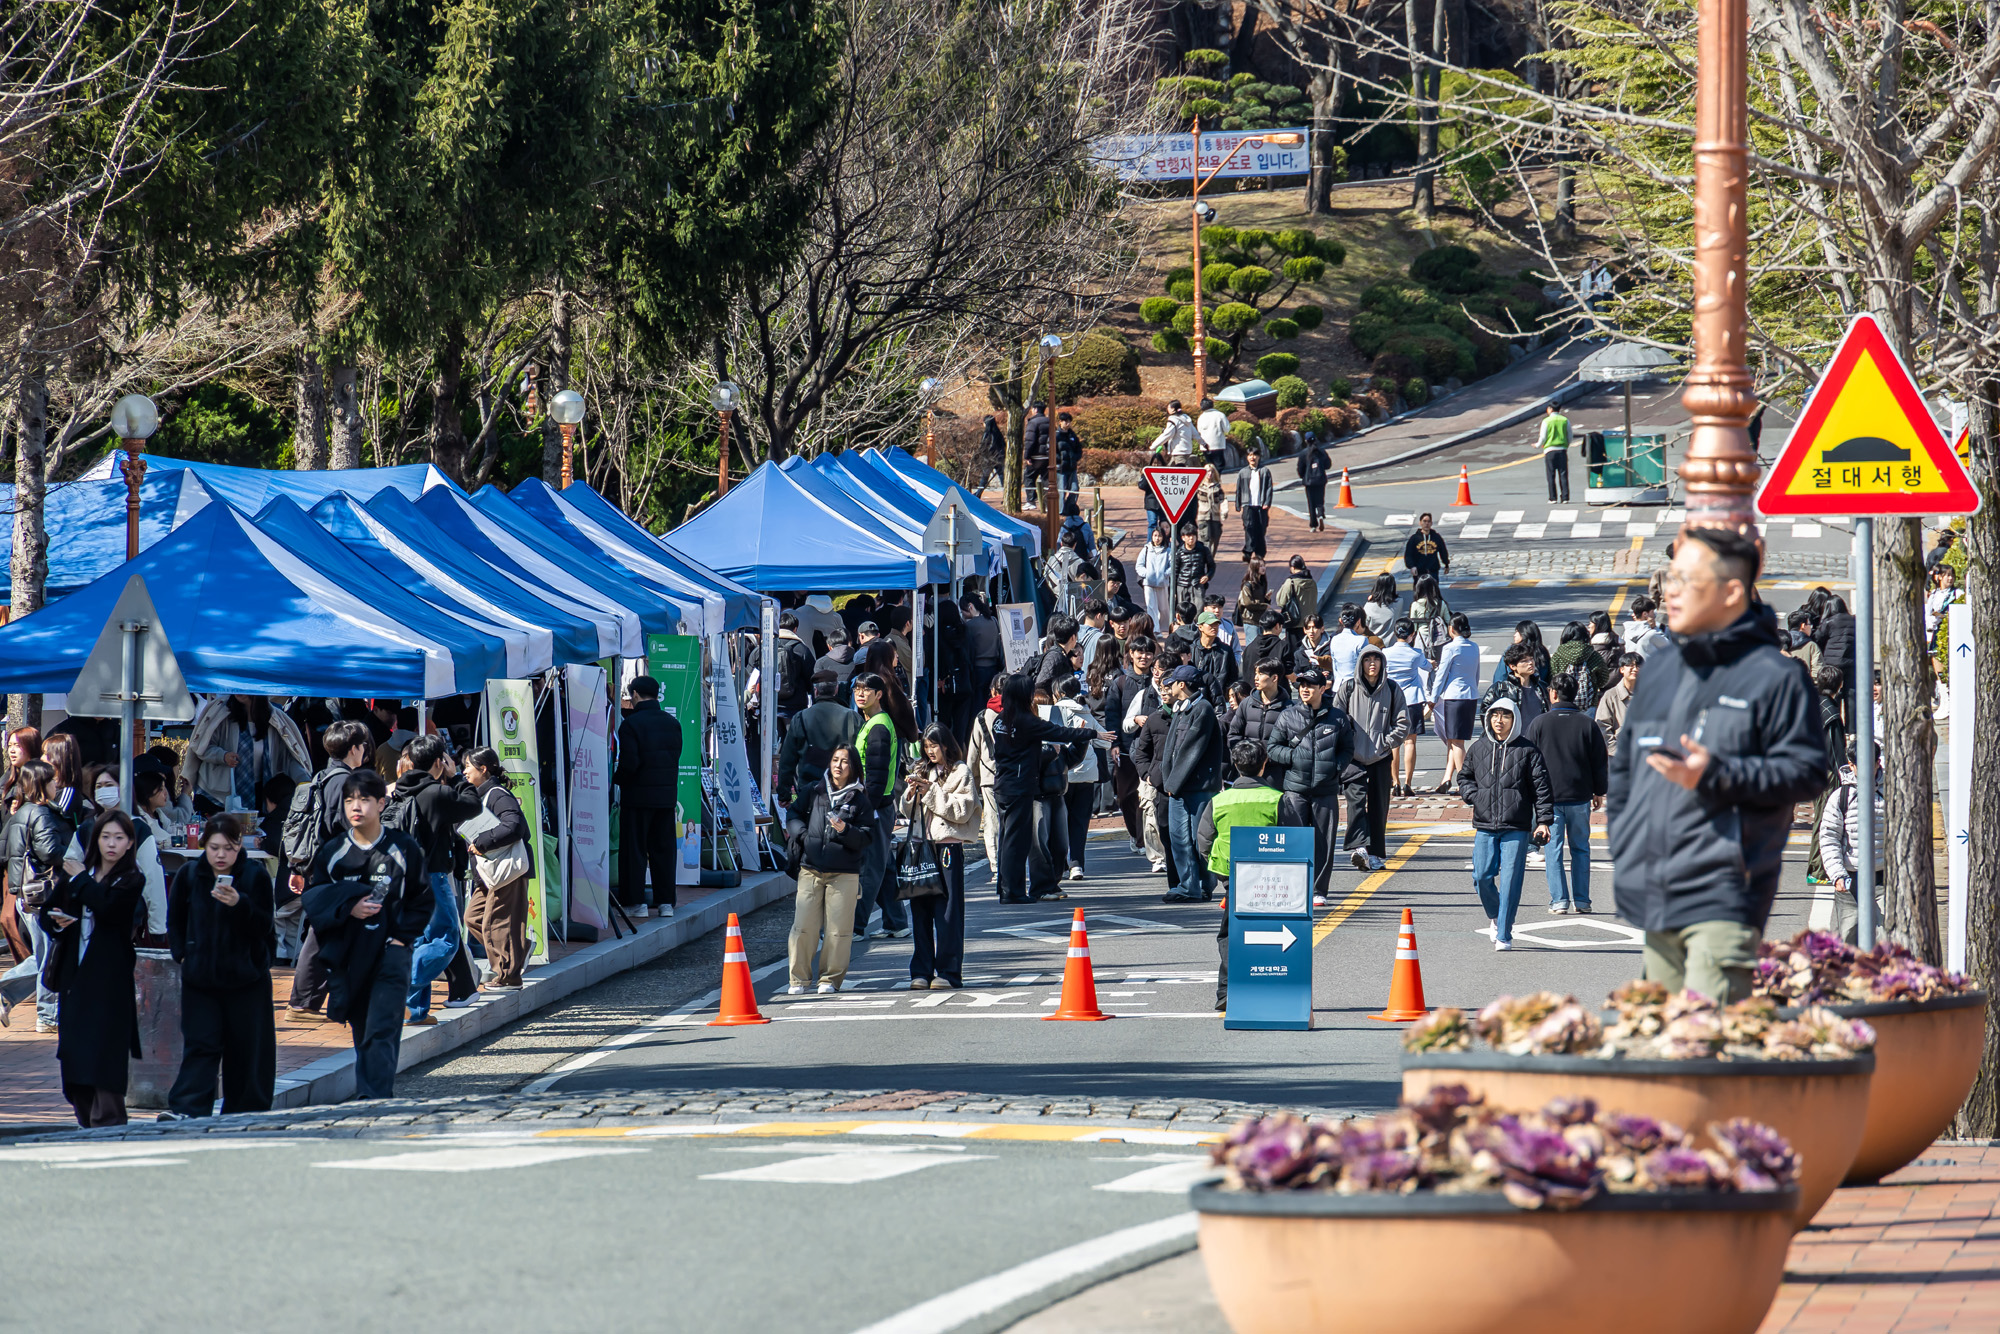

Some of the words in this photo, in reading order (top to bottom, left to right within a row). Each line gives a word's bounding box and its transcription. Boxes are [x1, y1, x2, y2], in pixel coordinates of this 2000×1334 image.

[1204, 138, 1212, 151] 등
[1228, 154, 1252, 170] 도로
[1258, 152, 1298, 170] 입니다.
[1160, 475, 1189, 486] 천천히
[1164, 487, 1186, 495] SLOW
[920, 862, 936, 870] Kim
